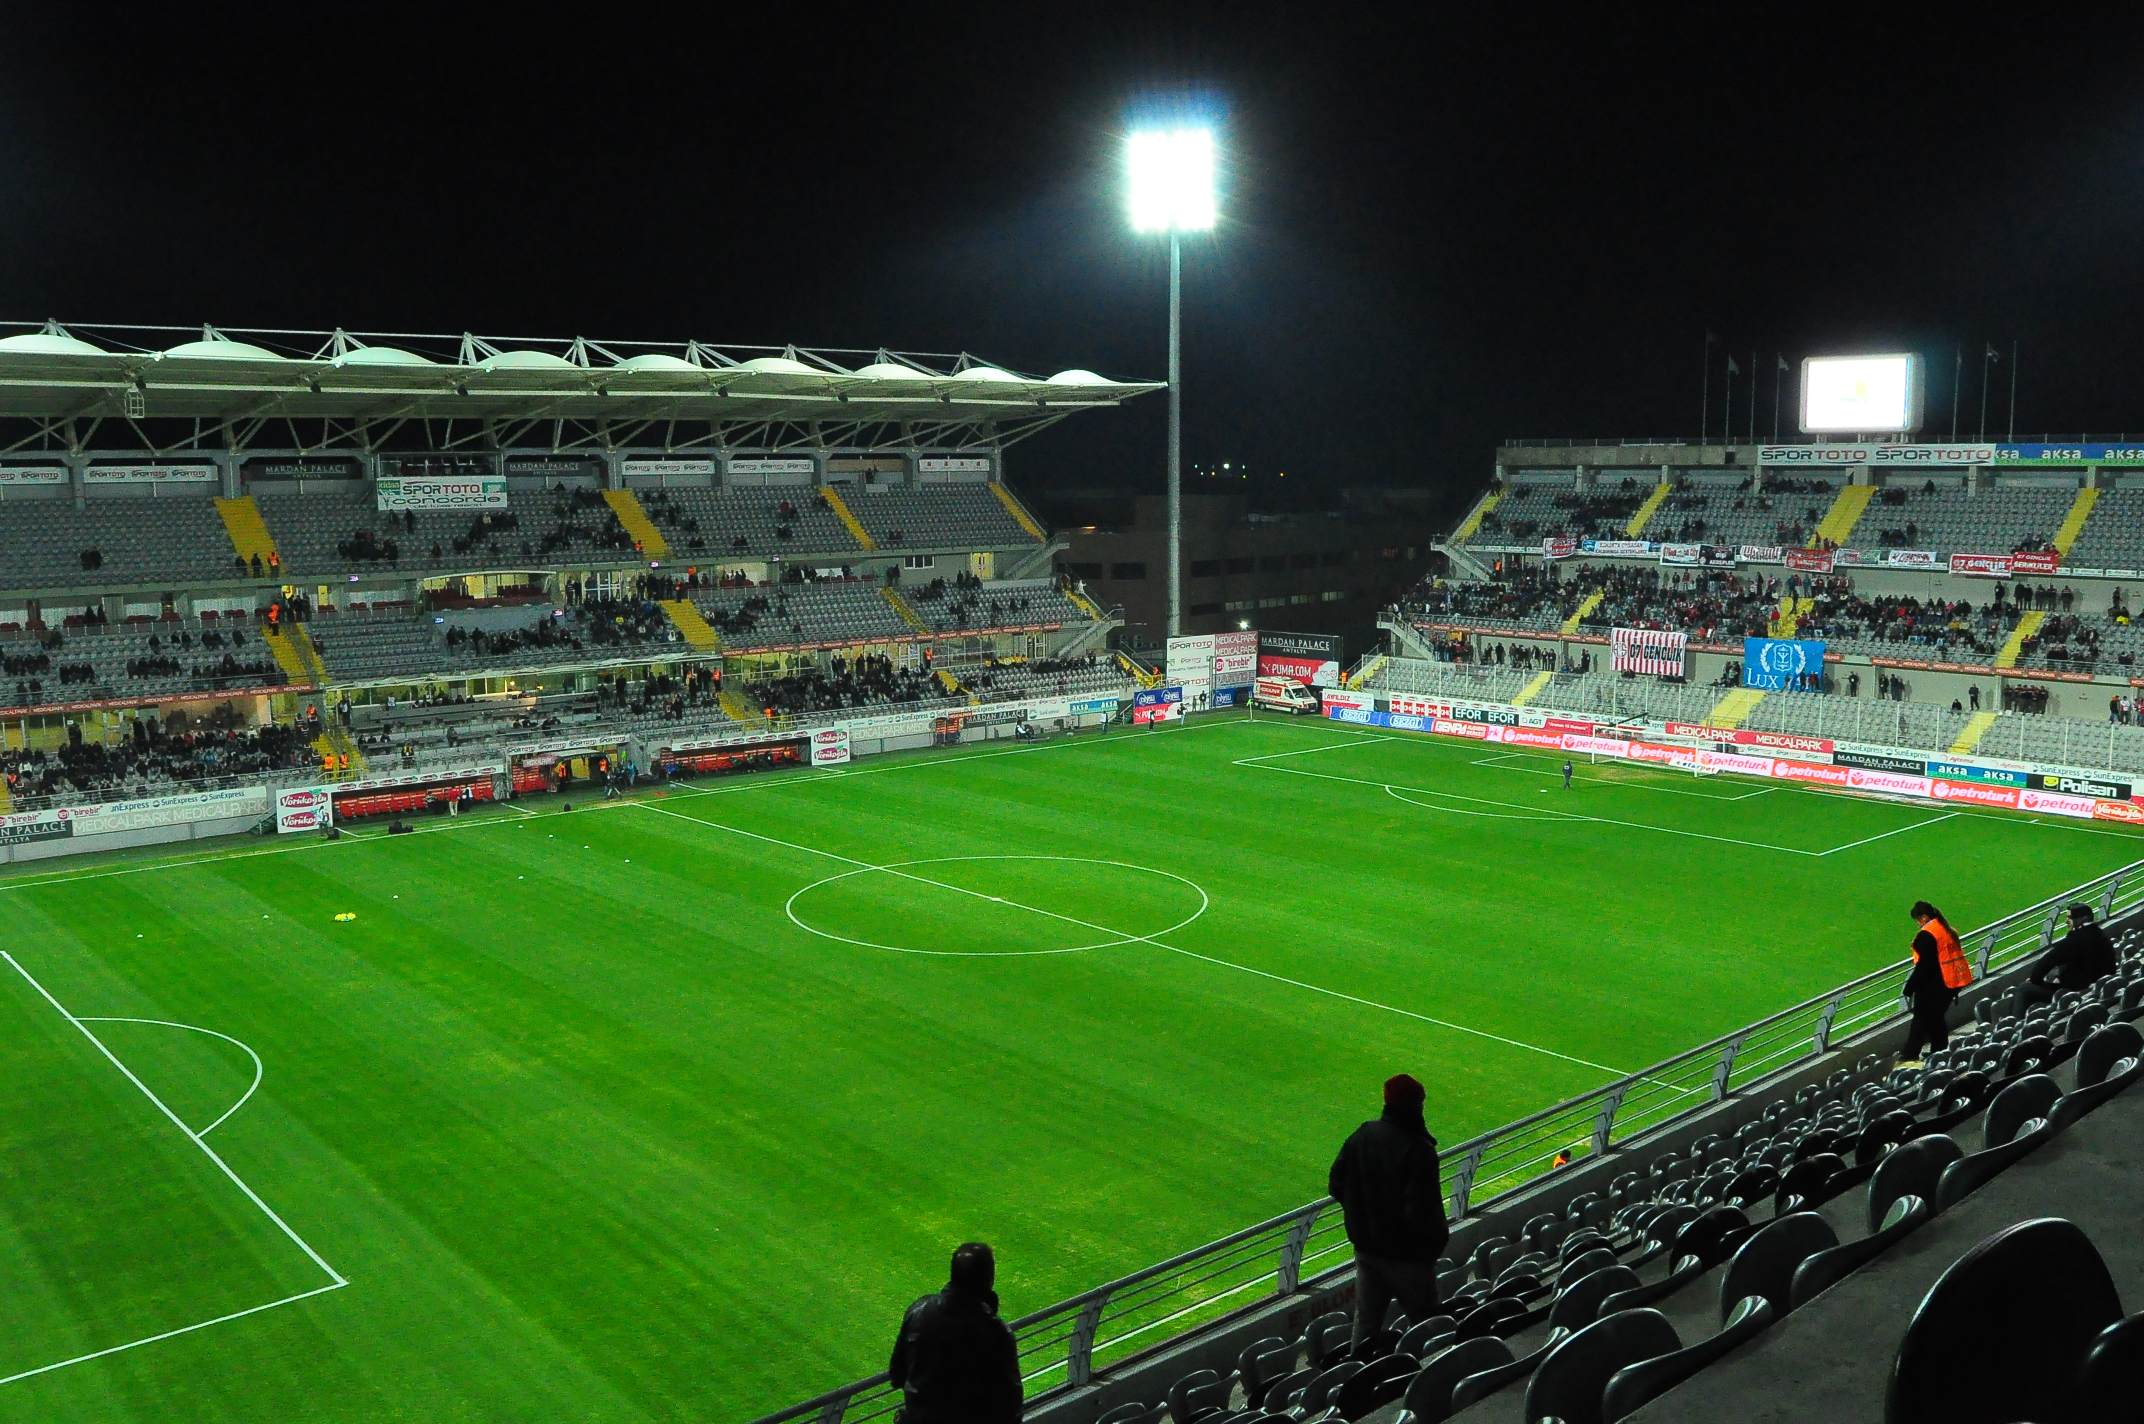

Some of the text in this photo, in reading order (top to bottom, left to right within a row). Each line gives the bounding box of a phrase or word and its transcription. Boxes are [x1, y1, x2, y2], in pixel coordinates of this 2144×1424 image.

[1994, 448, 2019, 459] ksa
[2041, 447, 2082, 459] aksa
[1262, 637, 1330, 650] MARDAN PALACE
[1630, 644, 1641, 658] 07
[1272, 664, 1311, 677] PUMA.COM
[1455, 708, 1481, 720] EFOR
[1488, 712, 1515, 724] EFOR
[1674, 726, 1736, 742] MEDICALPARK
[1756, 735, 1823, 751] MEDICALPARK
[1848, 743, 1883, 754] SunExpress
[1894, 749, 1930, 759] SunExpress
[1713, 756, 1768, 771] petroturk
[1837, 754, 1921, 770] MARDAN PALACE
[1788, 765, 1847, 782] petroturk
[1938, 765, 1967, 776] aksa
[1984, 770, 2014, 781] aksa
[2040, 765, 2081, 777] SunExpress
[1865, 776, 1927, 792] petroturk
[2093, 772, 2135, 783] SunExpress
[2059, 778, 2117, 798] Polisan
[161, 797, 198, 806] SunExpress
[208, 791, 245, 801] SunExpress
[1948, 787, 2017, 804] petroturk
[173, 800, 266, 823] MEDICALPARK
[17, 820, 67, 835] PALACE
[73, 811, 169, 835] MEDICALPARK
